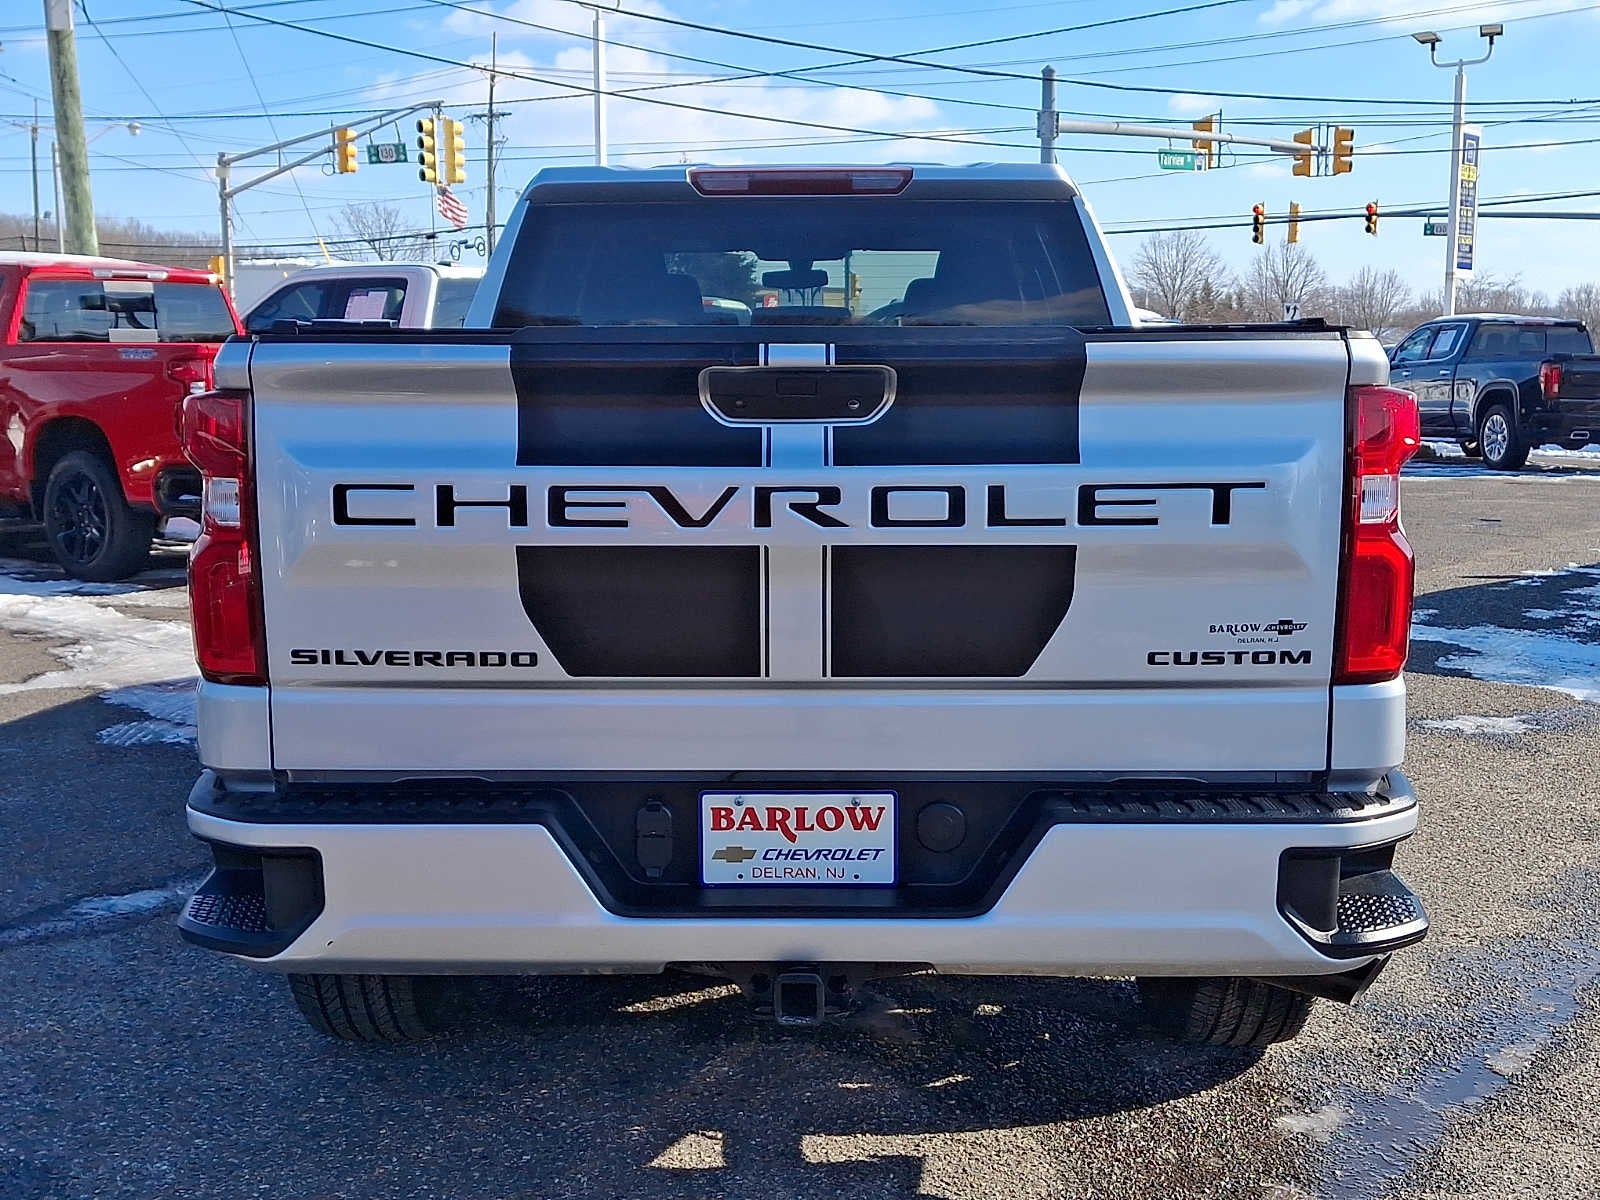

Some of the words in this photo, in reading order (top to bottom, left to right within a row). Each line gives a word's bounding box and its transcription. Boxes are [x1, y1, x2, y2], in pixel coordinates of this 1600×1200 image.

[332, 481, 1266, 529] CHEVROLET
[1209, 623, 1261, 636] BARLOW
[290, 648, 538, 668] SILVERADO
[1147, 650, 1312, 665] CUSTOM
[710, 806, 886, 843] BARLOW
[762, 848, 886, 861] CHEVROLET
[751, 867, 821, 880] DELRAN,
[826, 867, 845, 879] NJ
